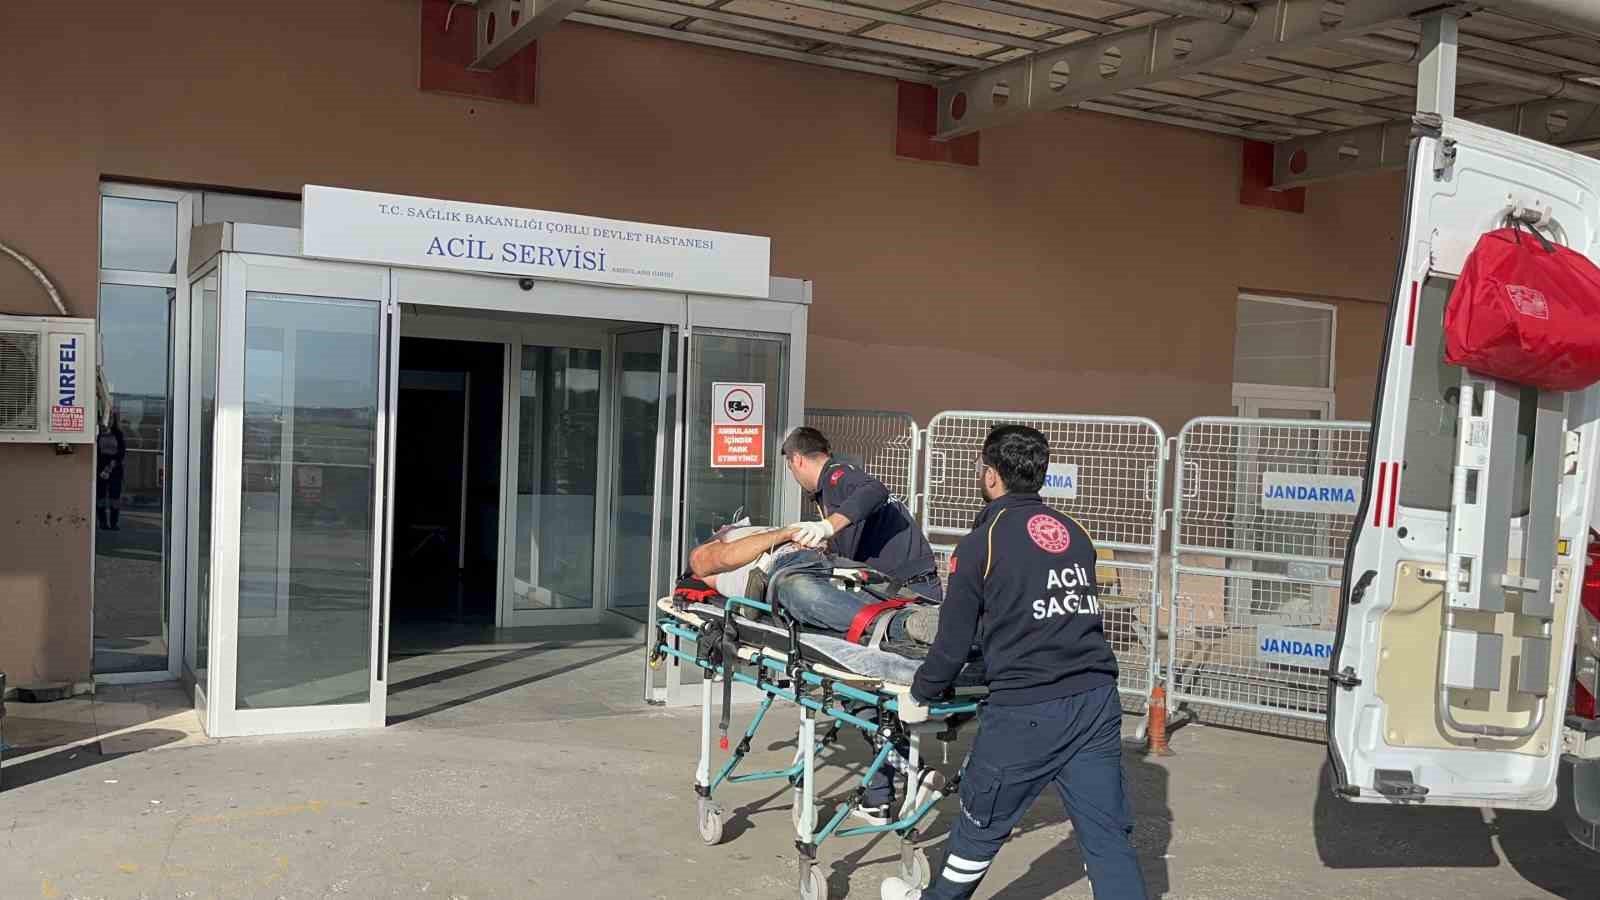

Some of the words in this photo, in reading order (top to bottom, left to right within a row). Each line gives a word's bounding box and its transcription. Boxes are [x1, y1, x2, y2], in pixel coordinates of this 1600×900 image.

[407, 206, 461, 222] SAĞLIK
[465, 213, 543, 231] BAKANLIĞI
[546, 221, 591, 236] ÇORLU
[593, 228, 642, 242] DEVLET
[426, 234, 494, 260] ACİL
[502, 242, 607, 272] SERVİSİ
[59, 338, 76, 406] AIRFEL
[1264, 485, 1356, 502] JANDARMA
[1047, 563, 1091, 590] ACİL
[1260, 638, 1336, 657] JANDARM
